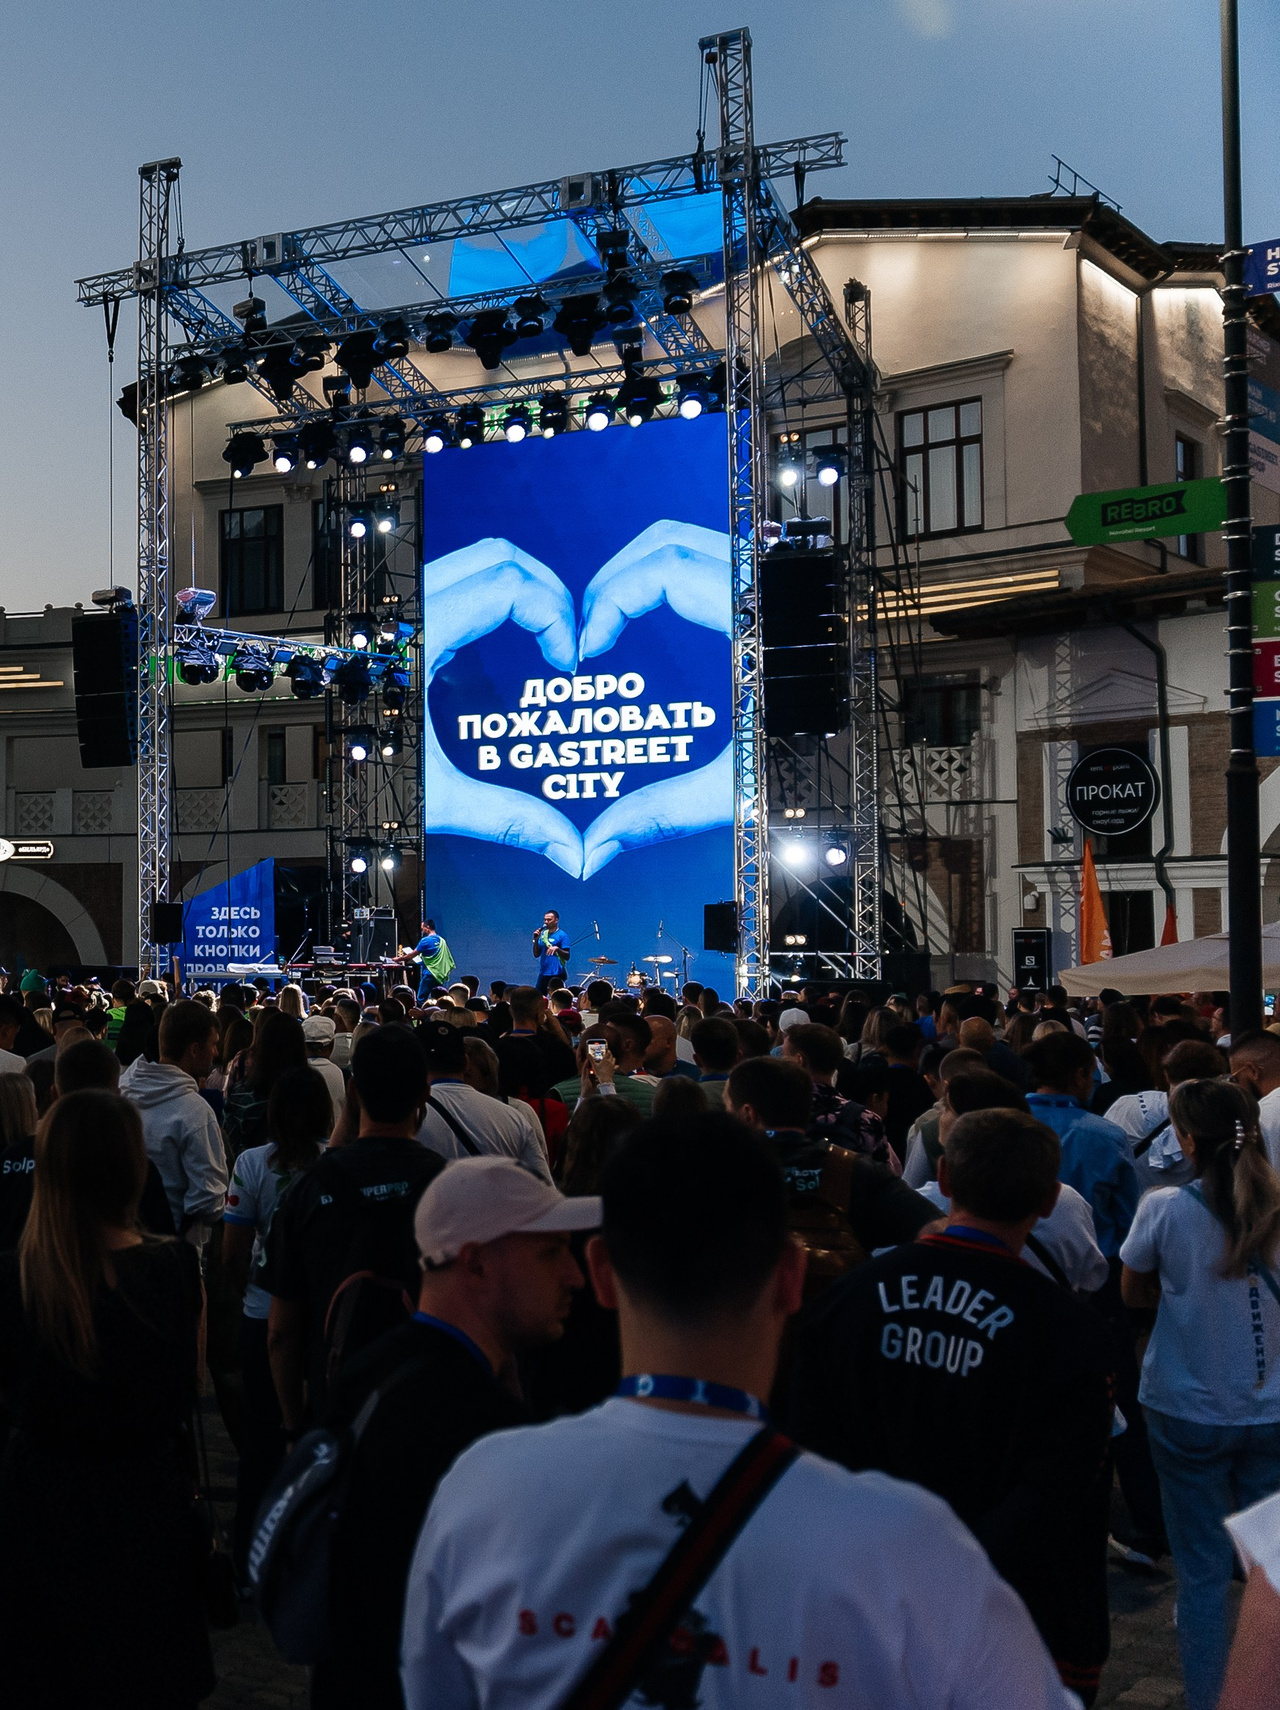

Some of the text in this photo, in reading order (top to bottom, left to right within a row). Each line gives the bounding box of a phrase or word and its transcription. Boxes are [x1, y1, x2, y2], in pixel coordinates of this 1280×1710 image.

[1107, 496, 1177, 522] REBRO
[520, 672, 646, 708] ДОБРО
[458, 701, 717, 741] ПОЖАЛОВАТЬ
[478, 735, 695, 771] В GASTREET
[541, 770, 626, 800] CITY
[1076, 782, 1146, 801] ПРОКАТ
[210, 906, 261, 921] ЗДЕСЬ
[195, 925, 261, 938] ТОЛЬКО
[194, 944, 261, 957] КНОПКИ
[2, 1156, 36, 1175] Solp
[877, 1274, 1016, 1341] LEADER
[1249, 1287, 1266, 1381] ДВИЖЕНИЕ
[880, 1322, 985, 1378] GROUP
